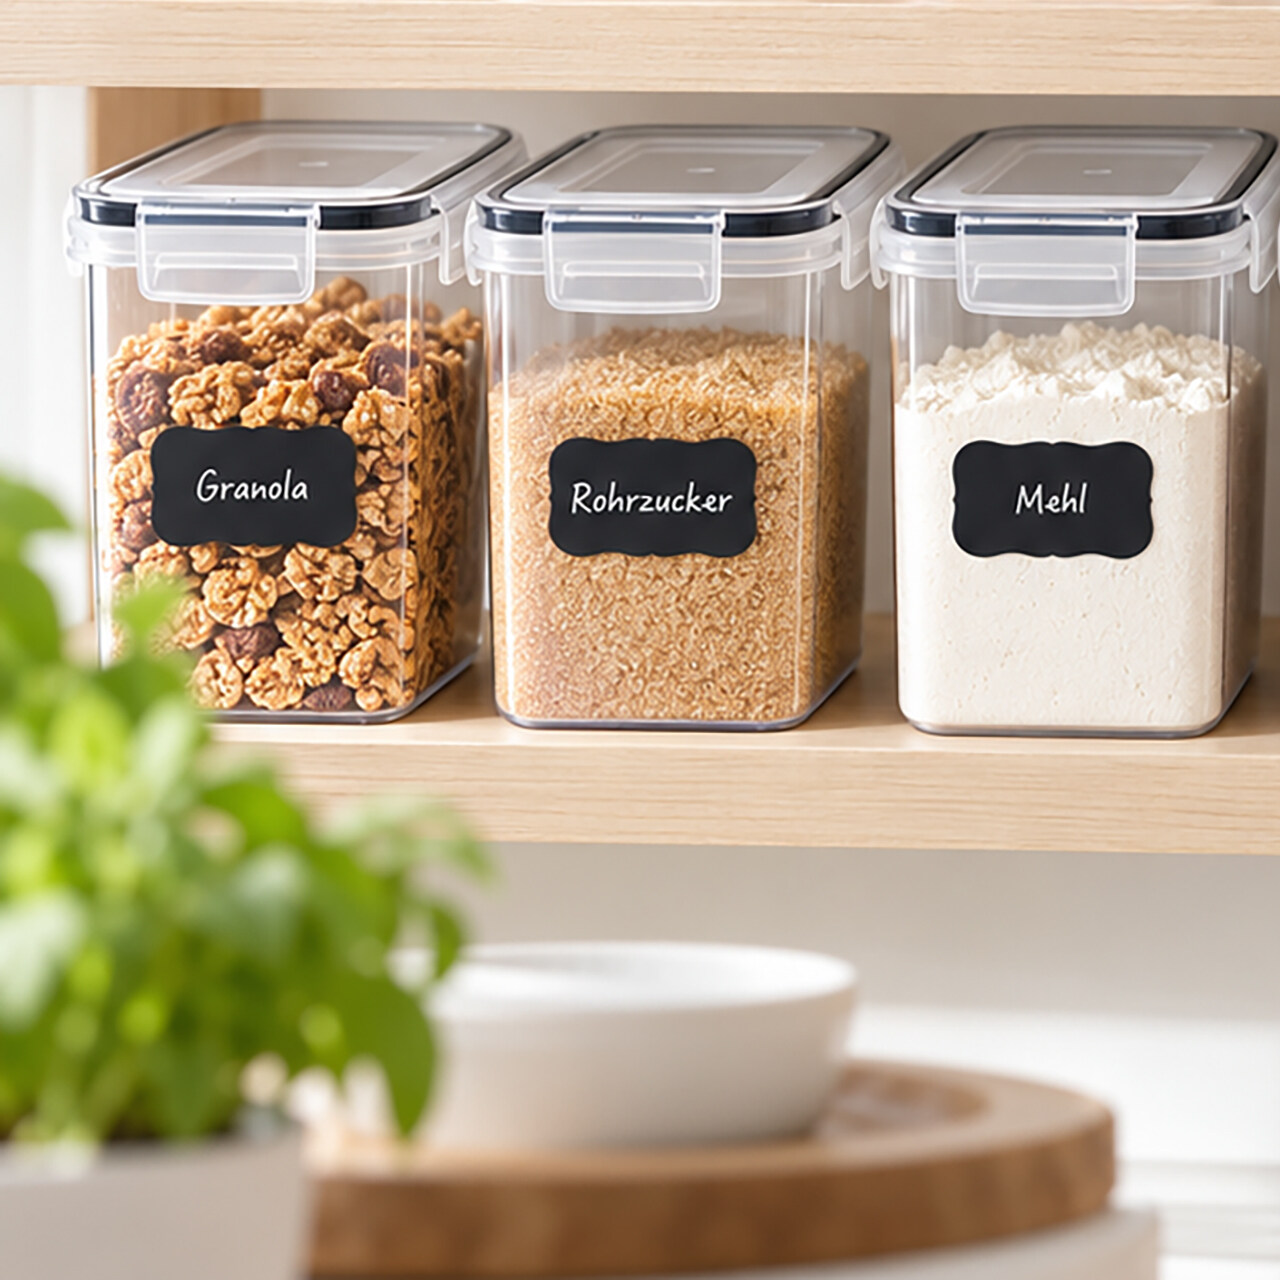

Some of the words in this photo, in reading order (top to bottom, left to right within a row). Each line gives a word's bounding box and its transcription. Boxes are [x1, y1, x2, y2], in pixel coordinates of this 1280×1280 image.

[196, 468, 308, 503] Granola
[571, 480, 733, 515] Rohrzucker
[1015, 482, 1088, 515] Mehl
